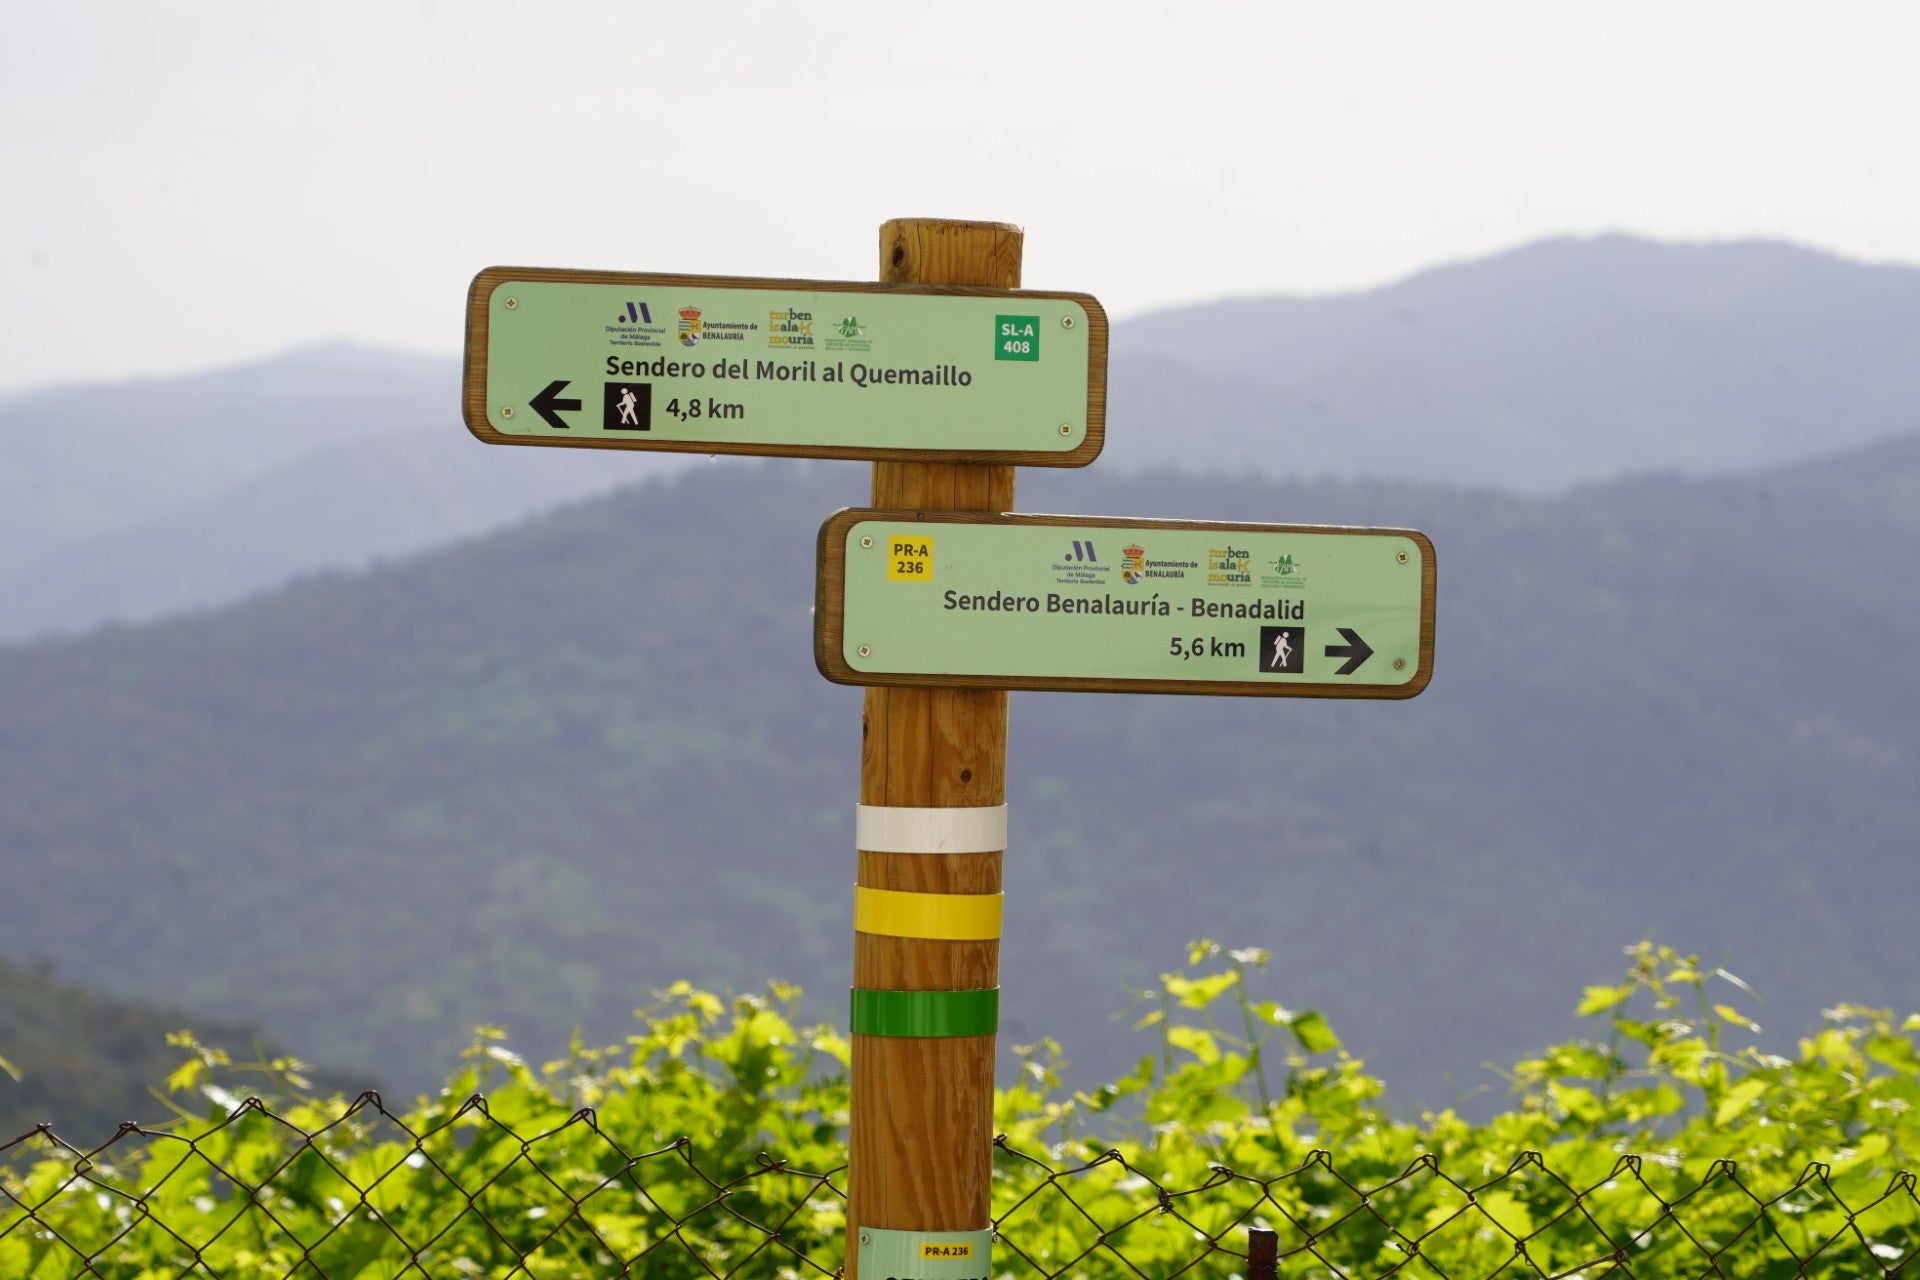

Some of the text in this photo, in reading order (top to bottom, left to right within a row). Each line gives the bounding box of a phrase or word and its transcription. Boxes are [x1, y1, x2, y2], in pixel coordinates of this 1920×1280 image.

[702, 321, 749, 331] Ayuntamiento
[1001, 323, 1034, 336] SL-A
[702, 332, 744, 341] BENALAURÍA
[1003, 340, 1031, 354] 408
[606, 355, 972, 388] Sendero del Moril al Quemaillo
[665, 398, 744, 422] 4,8 km
[893, 543, 929, 557] PR-A
[897, 561, 924, 574] 236
[1145, 559, 1189, 569] Ayuntamiento
[1145, 570, 1185, 578] BENALAURÍA
[943, 590, 1040, 612] Sendero
[1047, 592, 1170, 616] Benalauría
[1191, 598, 1304, 620] Benadalid
[1169, 636, 1245, 661] 5,6 km
[925, 1247, 969, 1256] PR-A 236
